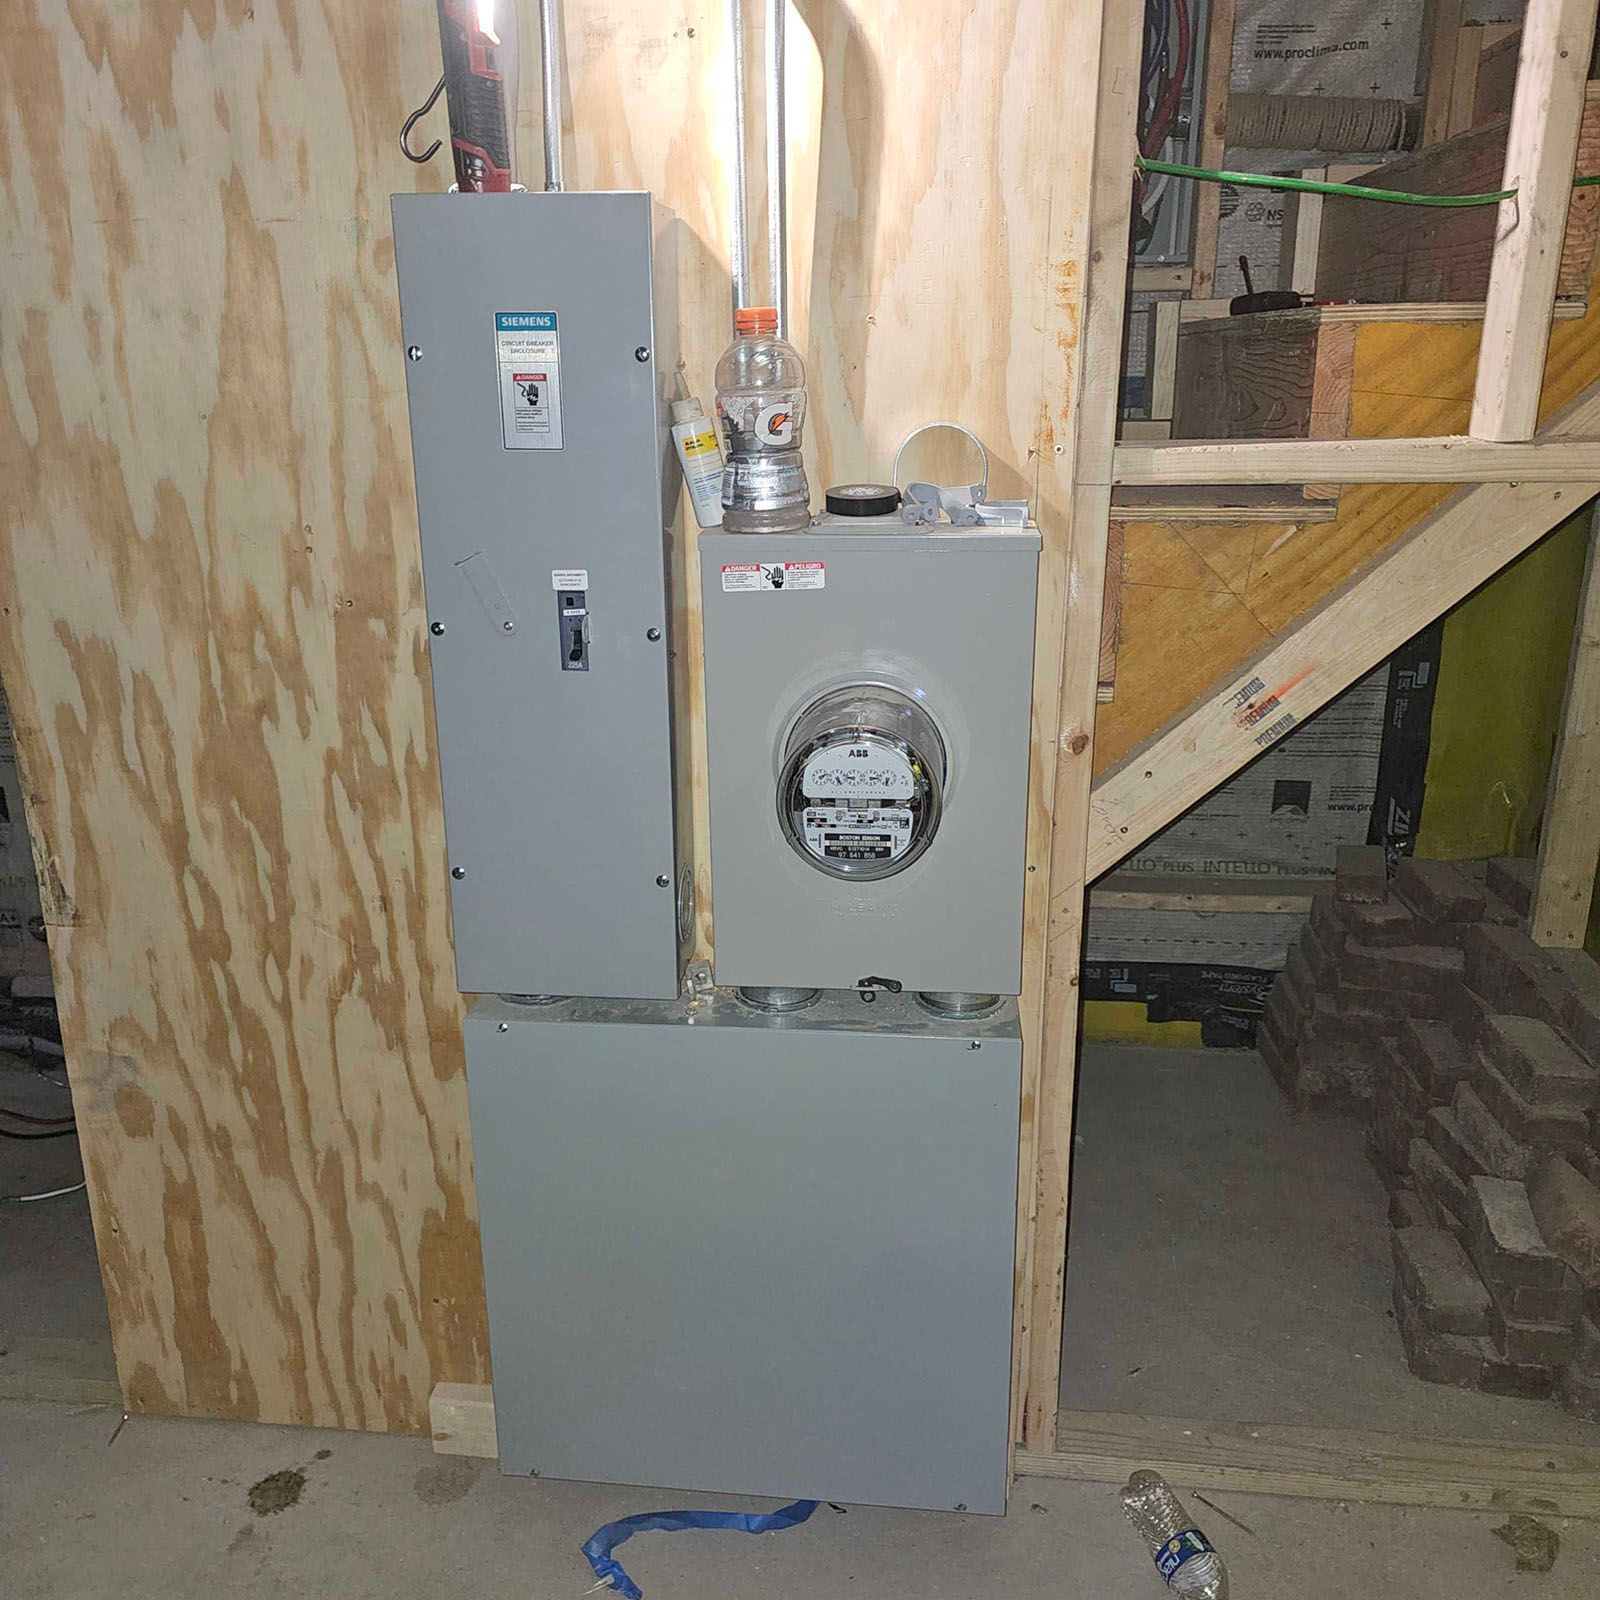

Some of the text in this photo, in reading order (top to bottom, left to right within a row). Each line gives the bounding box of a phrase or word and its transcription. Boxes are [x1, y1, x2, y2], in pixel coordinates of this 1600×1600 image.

[1254, 40, 1369, 61] www.proclima.com
[501, 316, 551, 327] SIEMENS
[754, 402, 794, 446] G
[848, 749, 869, 758] ABB
[1162, 861, 1194, 872] PLUS
[1202, 859, 1270, 875] INTELLO
